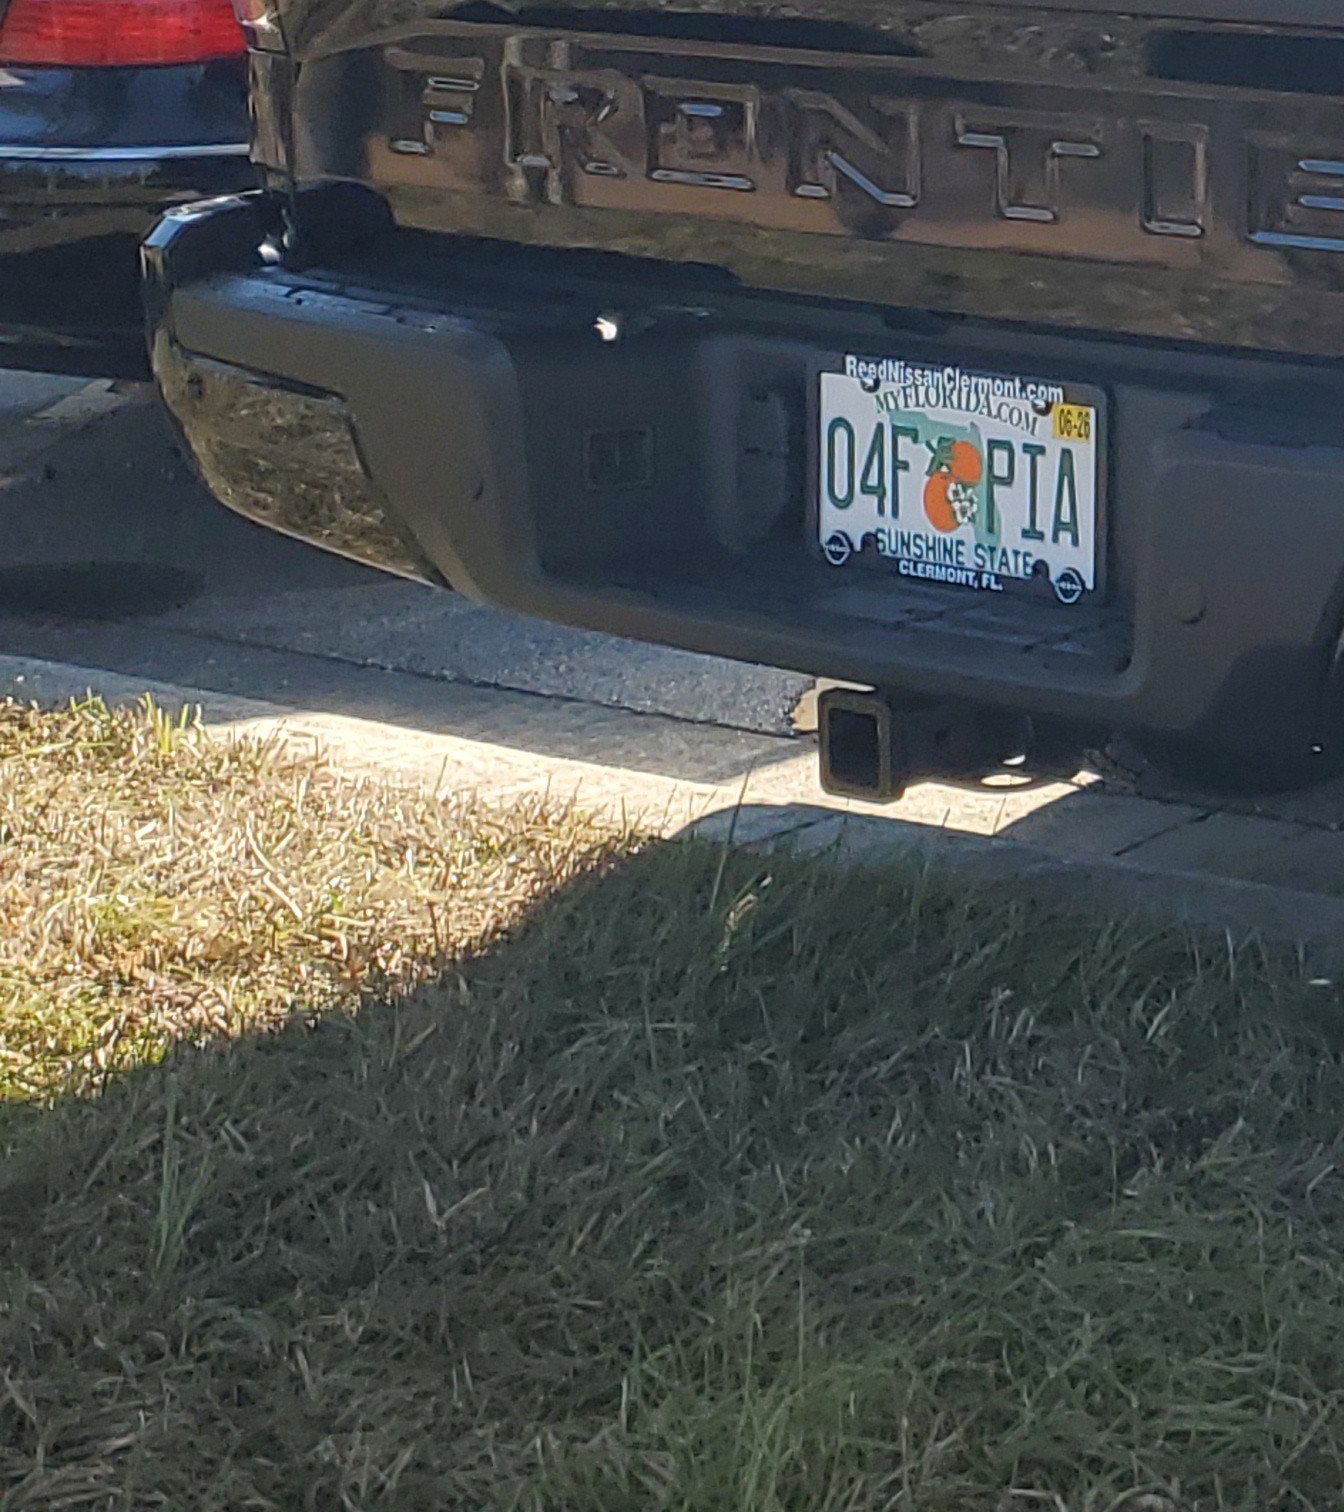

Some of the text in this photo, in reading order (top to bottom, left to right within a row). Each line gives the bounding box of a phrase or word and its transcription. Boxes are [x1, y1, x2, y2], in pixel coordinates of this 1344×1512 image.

[845, 354, 1064, 403] ReedNissanClermont.com
[984, 438, 1080, 547] PIA
[875, 527, 1033, 577] SUNSHINE STATE
